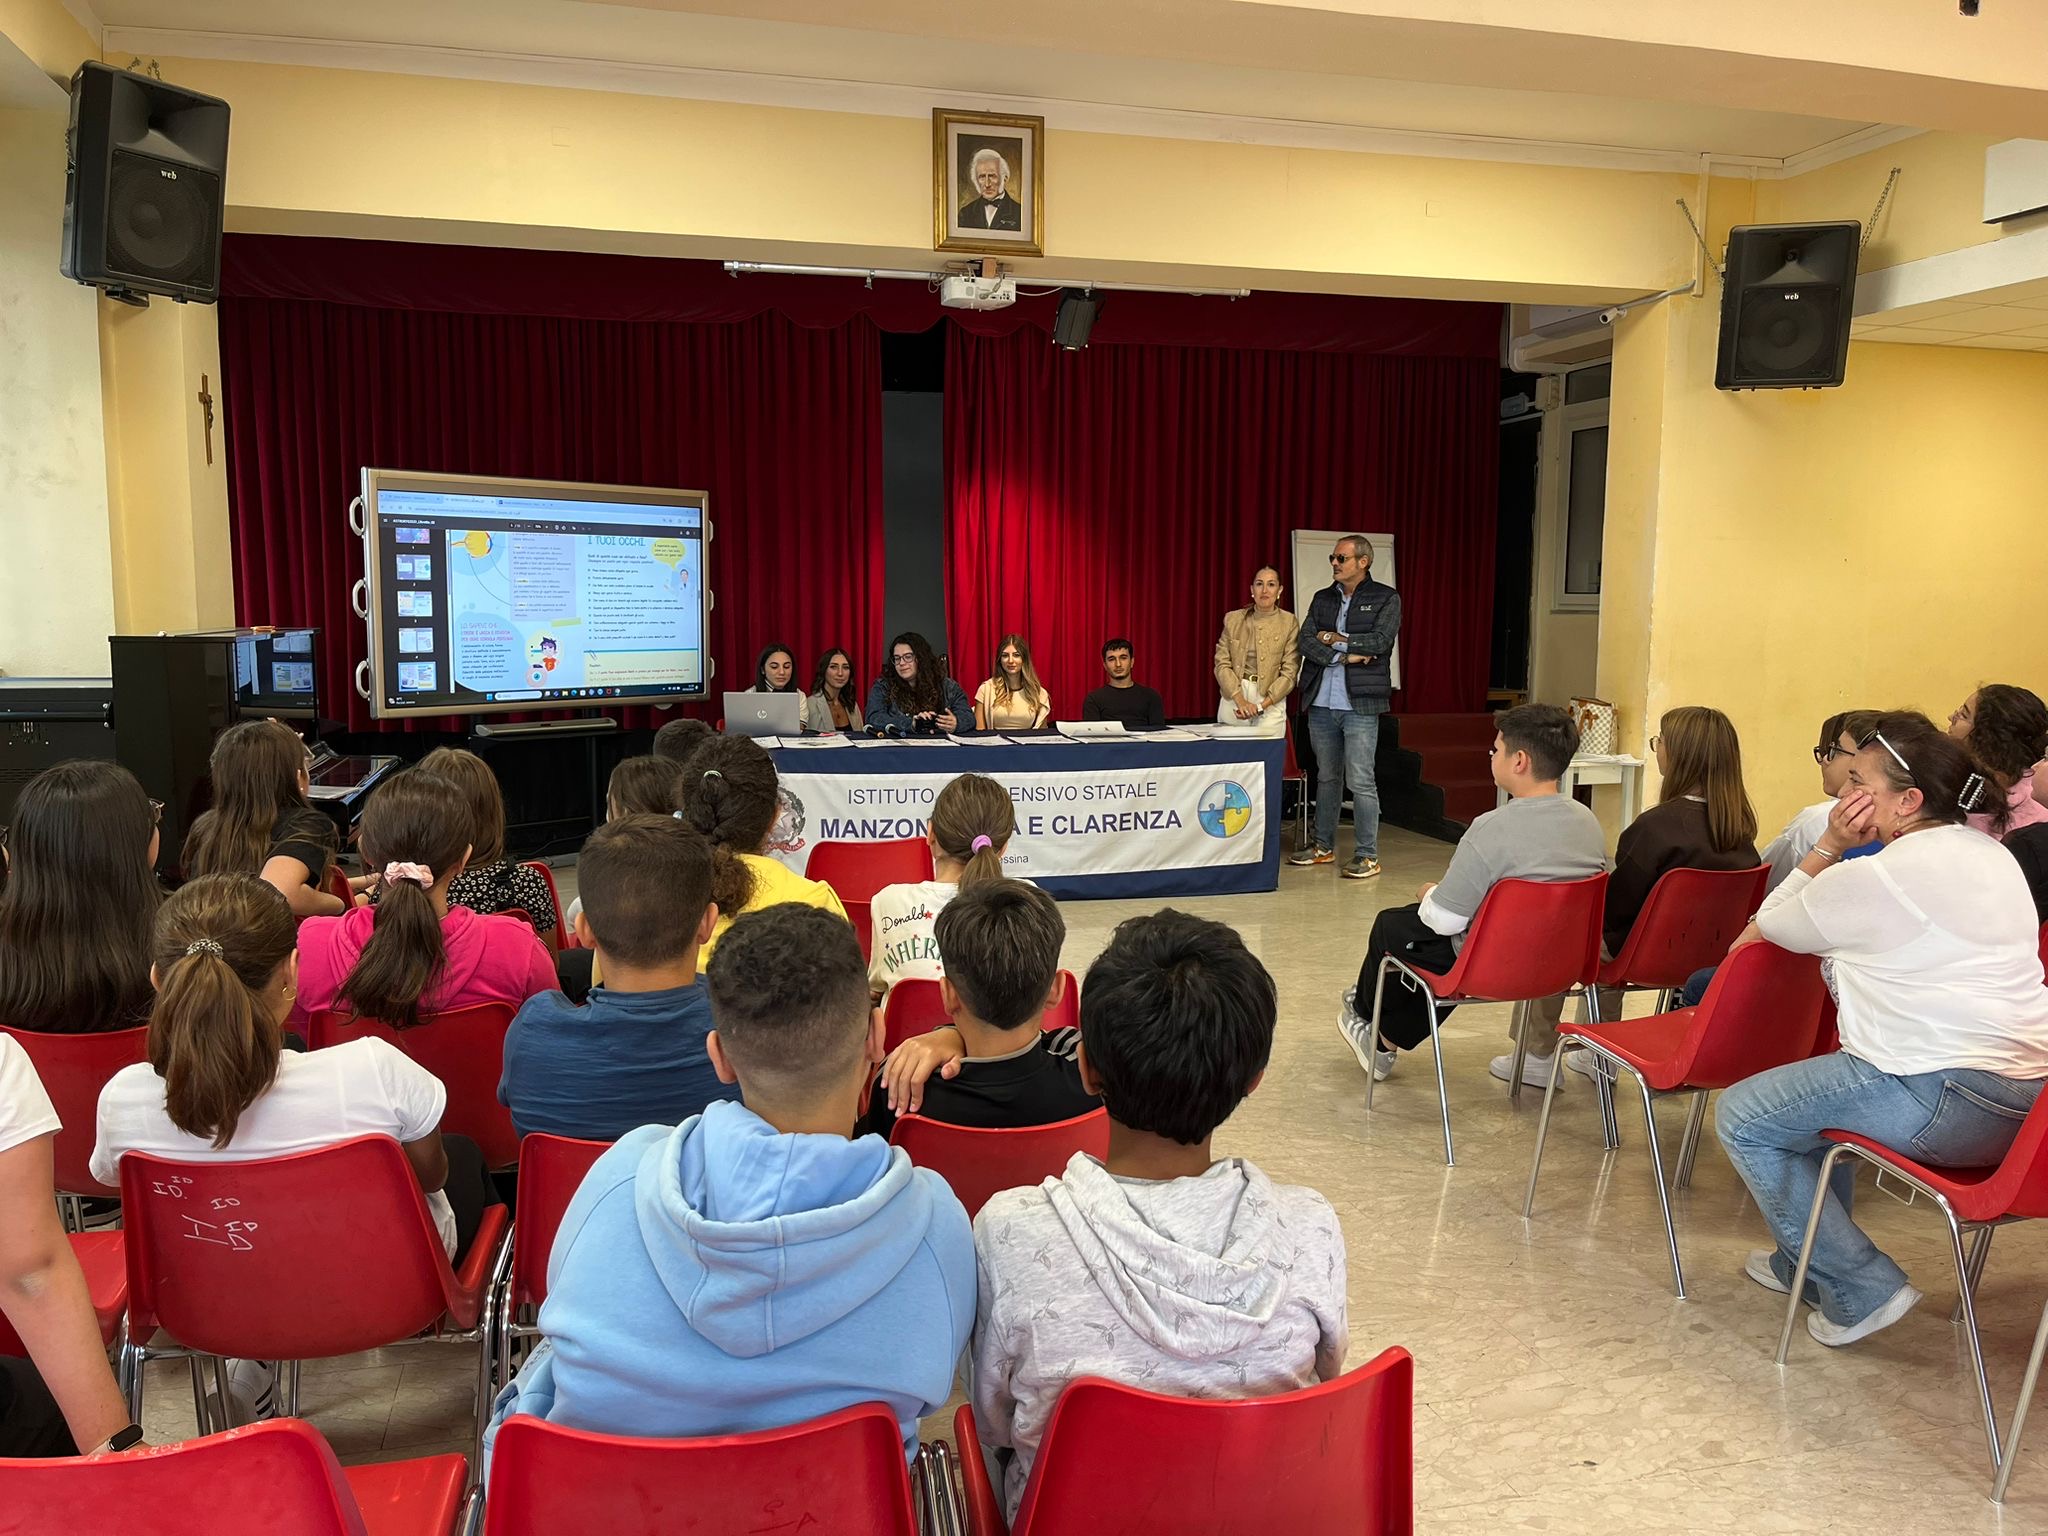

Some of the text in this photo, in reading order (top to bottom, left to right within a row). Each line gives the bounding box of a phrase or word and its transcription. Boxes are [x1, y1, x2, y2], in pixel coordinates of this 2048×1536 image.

[161, 170, 176, 180] web
[848, 782, 1157, 804] ISTITUTO ENSIVO STATALE
[820, 818, 928, 838] MANZON
[1028, 816, 1043, 835] E
[1052, 810, 1182, 834] CLARENZA
[1001, 854, 1029, 864] ssina
[881, 904, 926, 934] Donald
[883, 937, 942, 973] WHER
